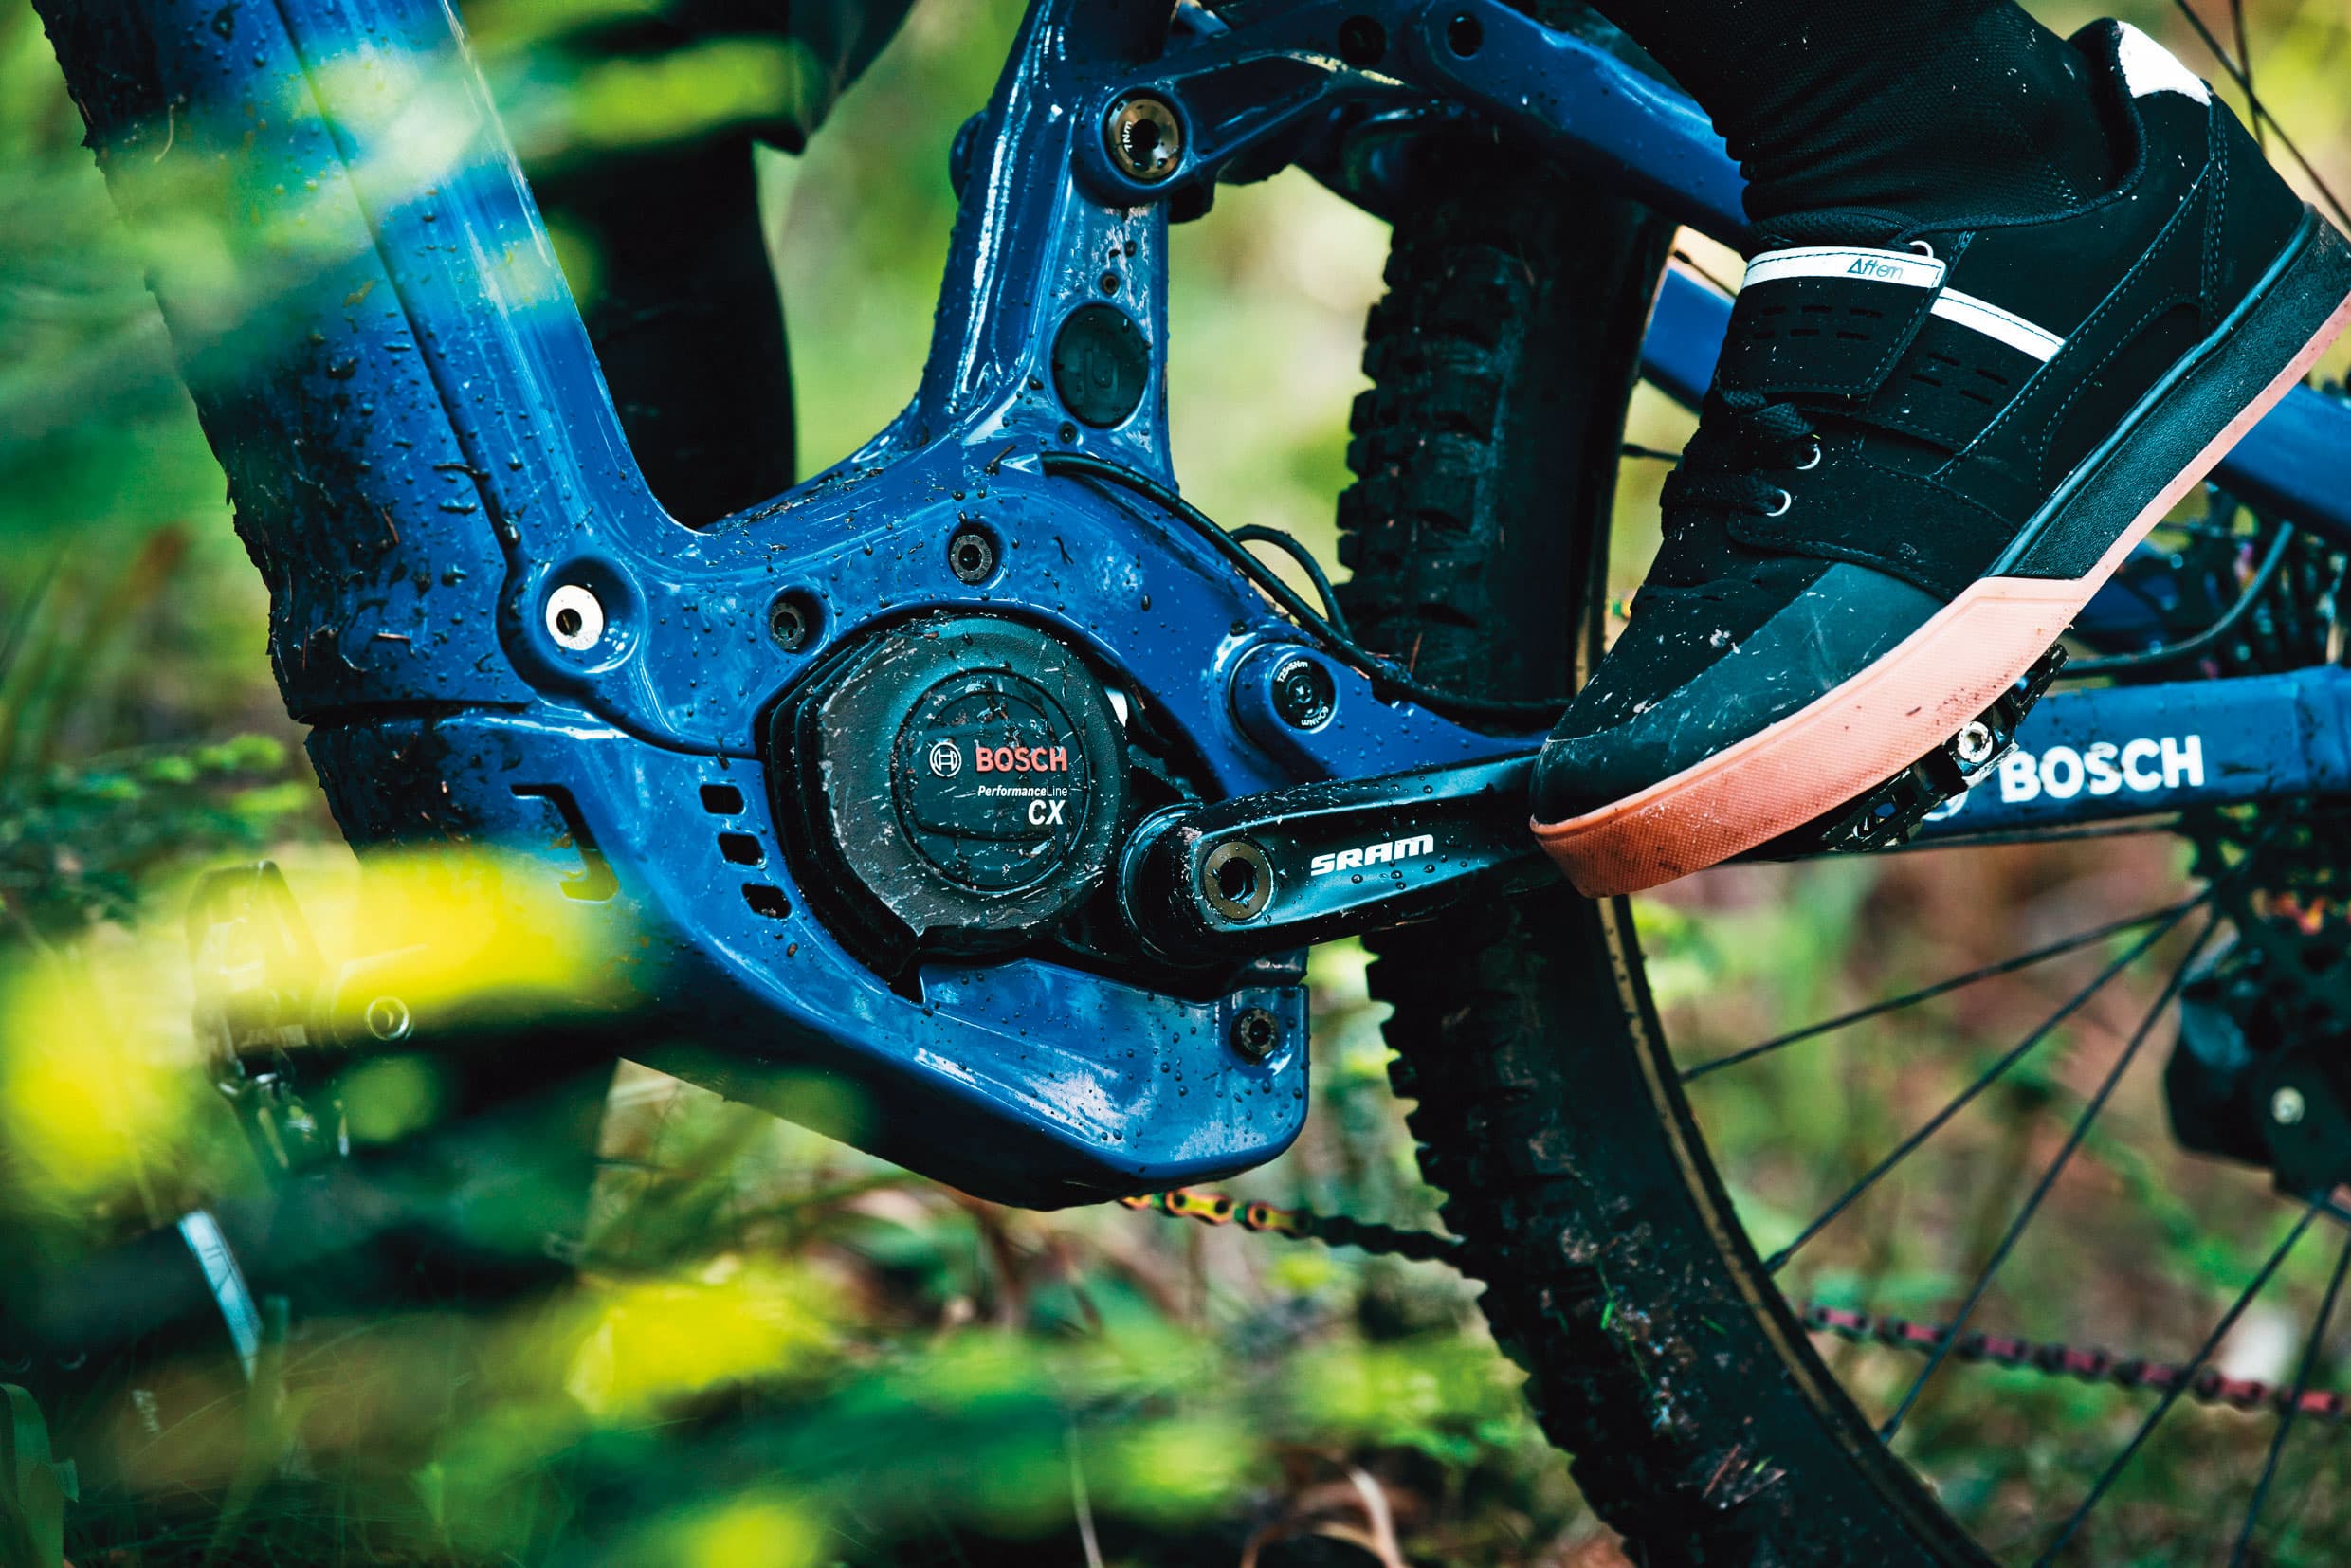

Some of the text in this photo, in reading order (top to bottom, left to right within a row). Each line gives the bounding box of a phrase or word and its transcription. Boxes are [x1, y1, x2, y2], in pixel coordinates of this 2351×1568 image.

[975, 746, 1067, 772] BOSCH
[2001, 736, 2204, 803] BOSCH
[1028, 800, 1065, 825] CX
[1310, 834, 1433, 875] SRAM
